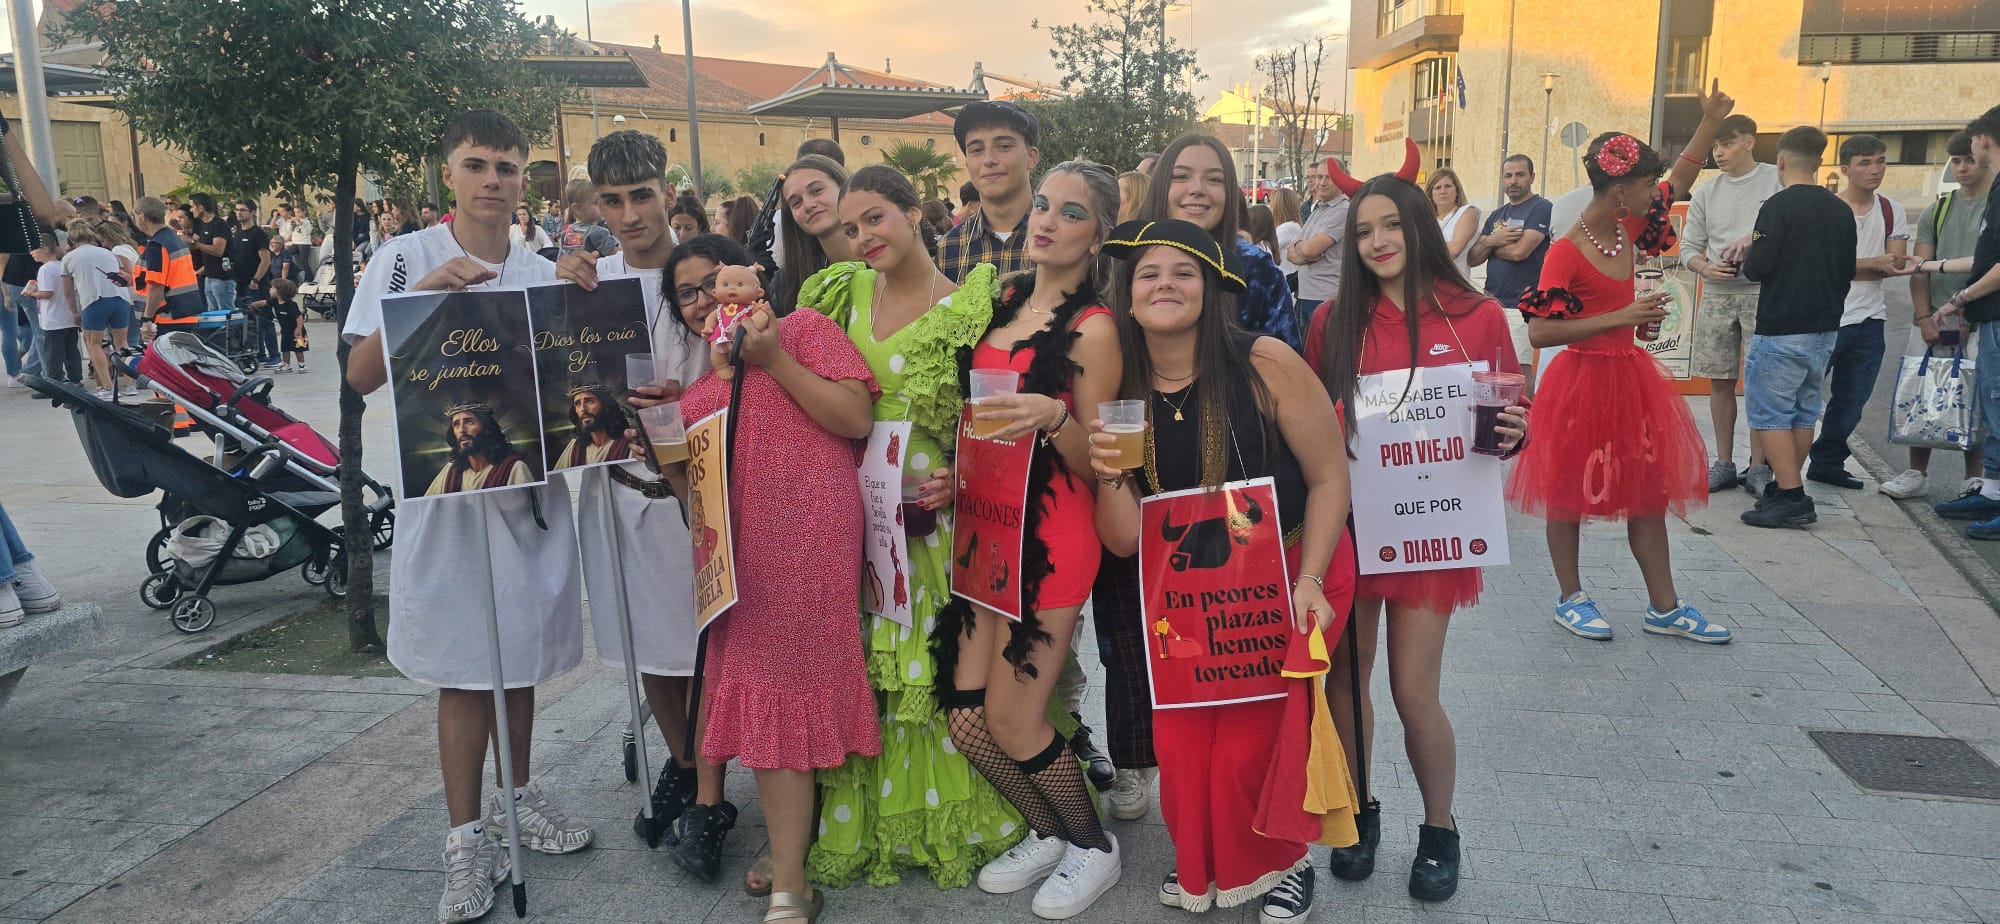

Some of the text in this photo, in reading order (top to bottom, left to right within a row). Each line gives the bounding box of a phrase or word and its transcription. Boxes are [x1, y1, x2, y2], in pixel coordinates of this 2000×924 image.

[387, 253, 407, 293] HOES
[441, 328, 501, 357] Ellos
[533, 331, 576, 351] Dios
[580, 326, 603, 344] los
[409, 360, 502, 391] se juntan
[1365, 384, 1468, 408] MÁS SABE EL
[1389, 405, 1446, 424] DIABLO
[1380, 435, 1465, 468] POR VIEJO
[957, 492, 1021, 529] TACONES
[1394, 498, 1462, 516] QUE POR
[1403, 536, 1463, 563] DIABLO
[713, 555, 726, 578] LA
[1165, 583, 1279, 613] En peores
[1206, 608, 1283, 638] plazas
[1209, 632, 1287, 657] hemos
